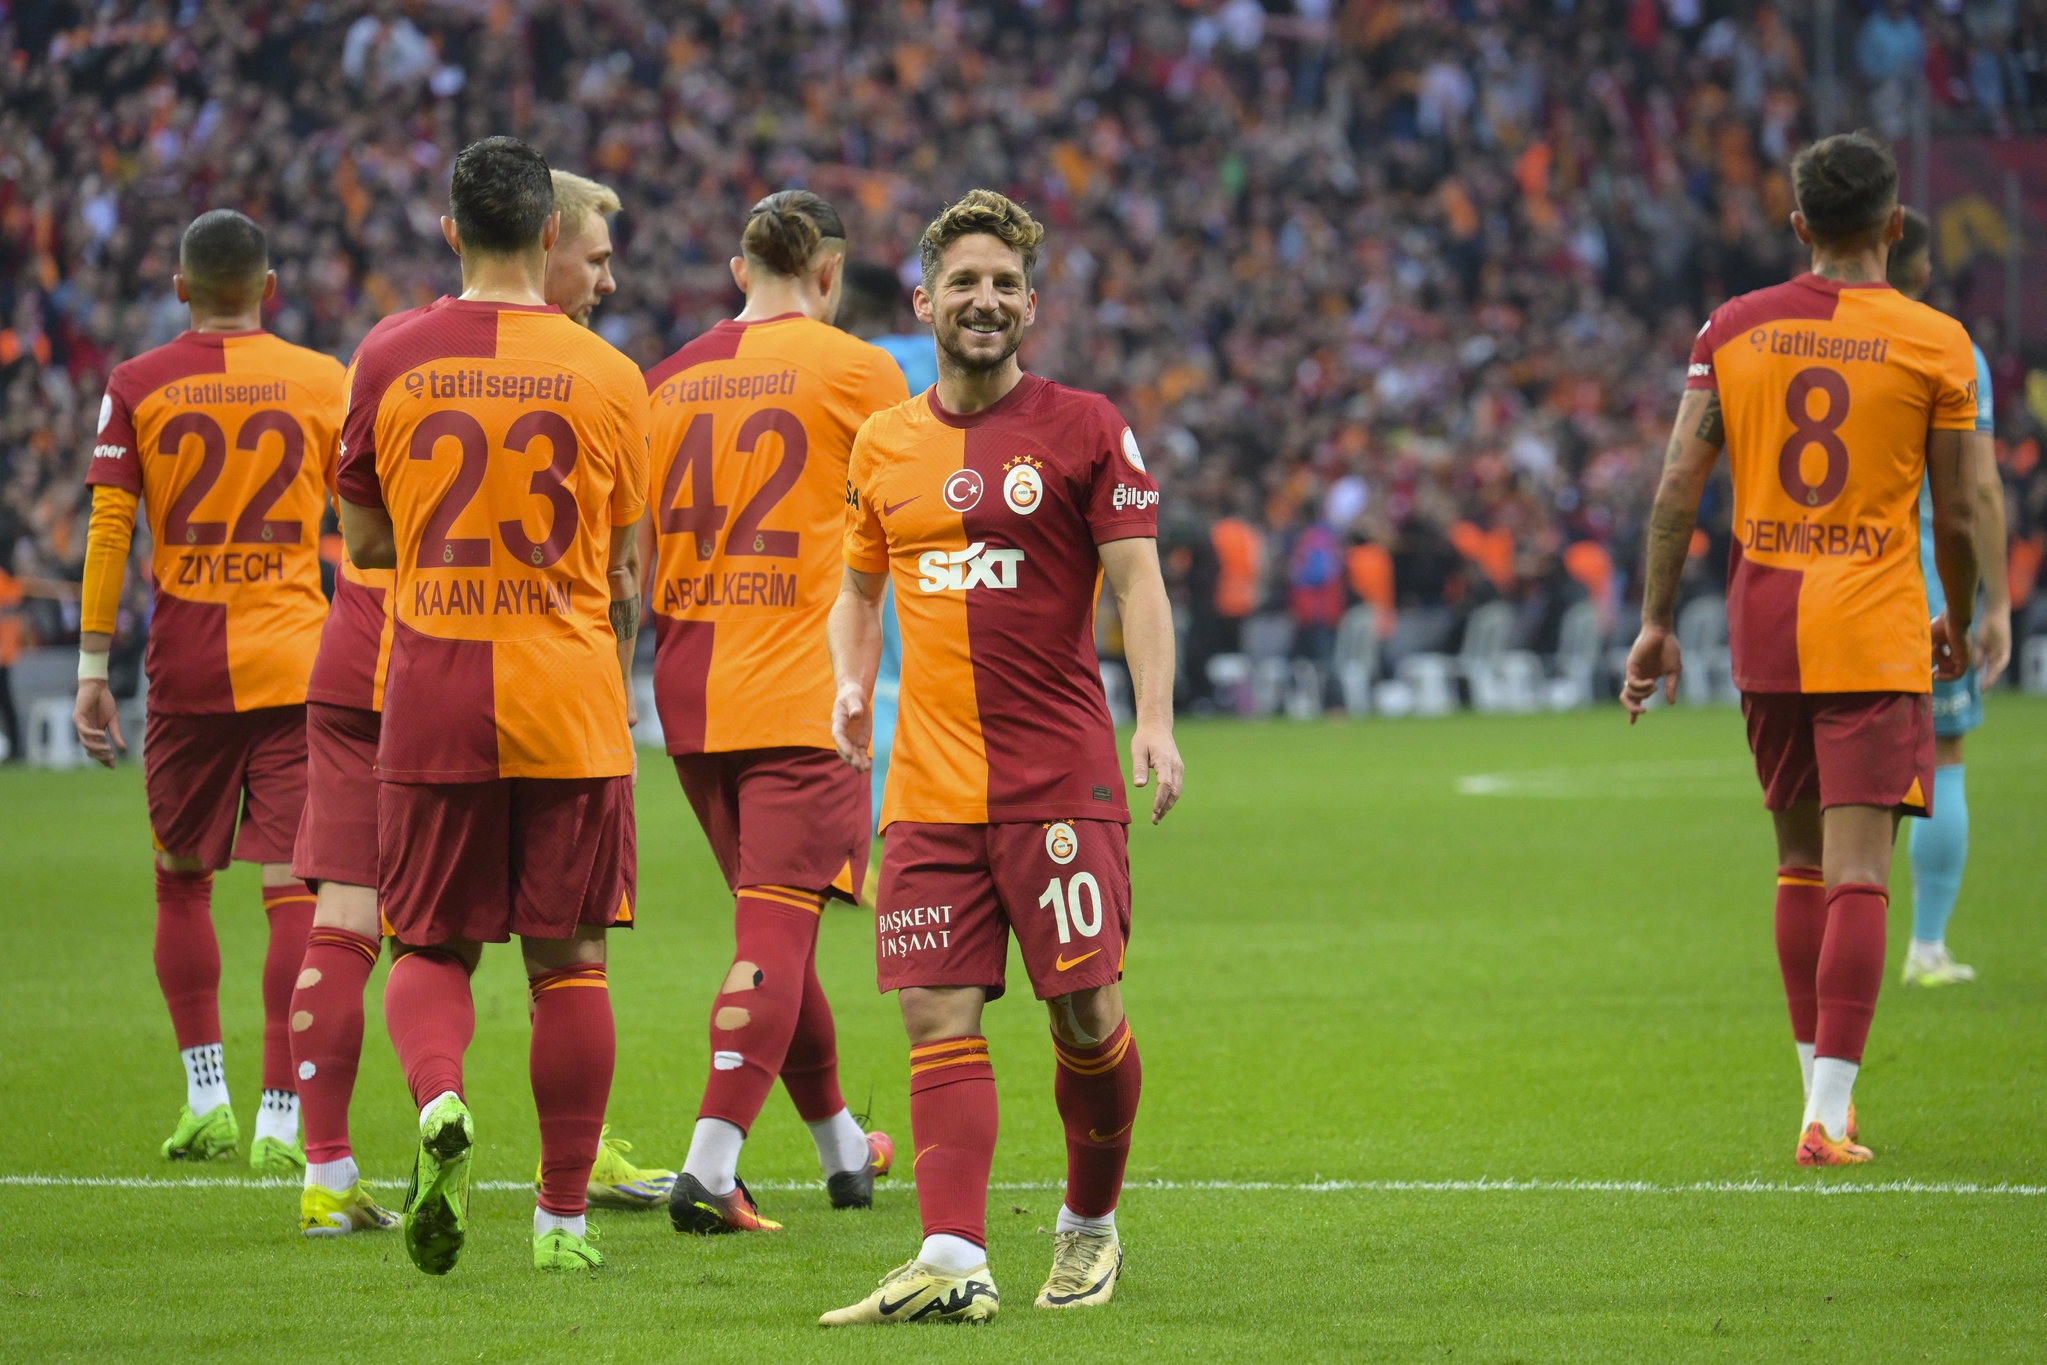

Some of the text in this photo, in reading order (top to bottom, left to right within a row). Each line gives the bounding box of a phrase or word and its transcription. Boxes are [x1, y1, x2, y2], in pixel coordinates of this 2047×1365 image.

[1771, 328, 1889, 364] tatilsepeti
[184, 380, 286, 406] tatilsepeti
[429, 369, 573, 403] tatilsepeti
[679, 369, 797, 402] tatilsepeti
[1778, 366, 1851, 509] 8
[158, 409, 305, 546] 22
[408, 409, 579, 569] 23
[658, 407, 808, 562] 42
[178, 552, 283, 585] ZIYECH
[414, 579, 573, 617] KAAN AYHAN
[879, 905, 953, 934] BAŞKENT
[1039, 871, 1103, 944] 10
[881, 930, 950, 958] İNŞAAT
